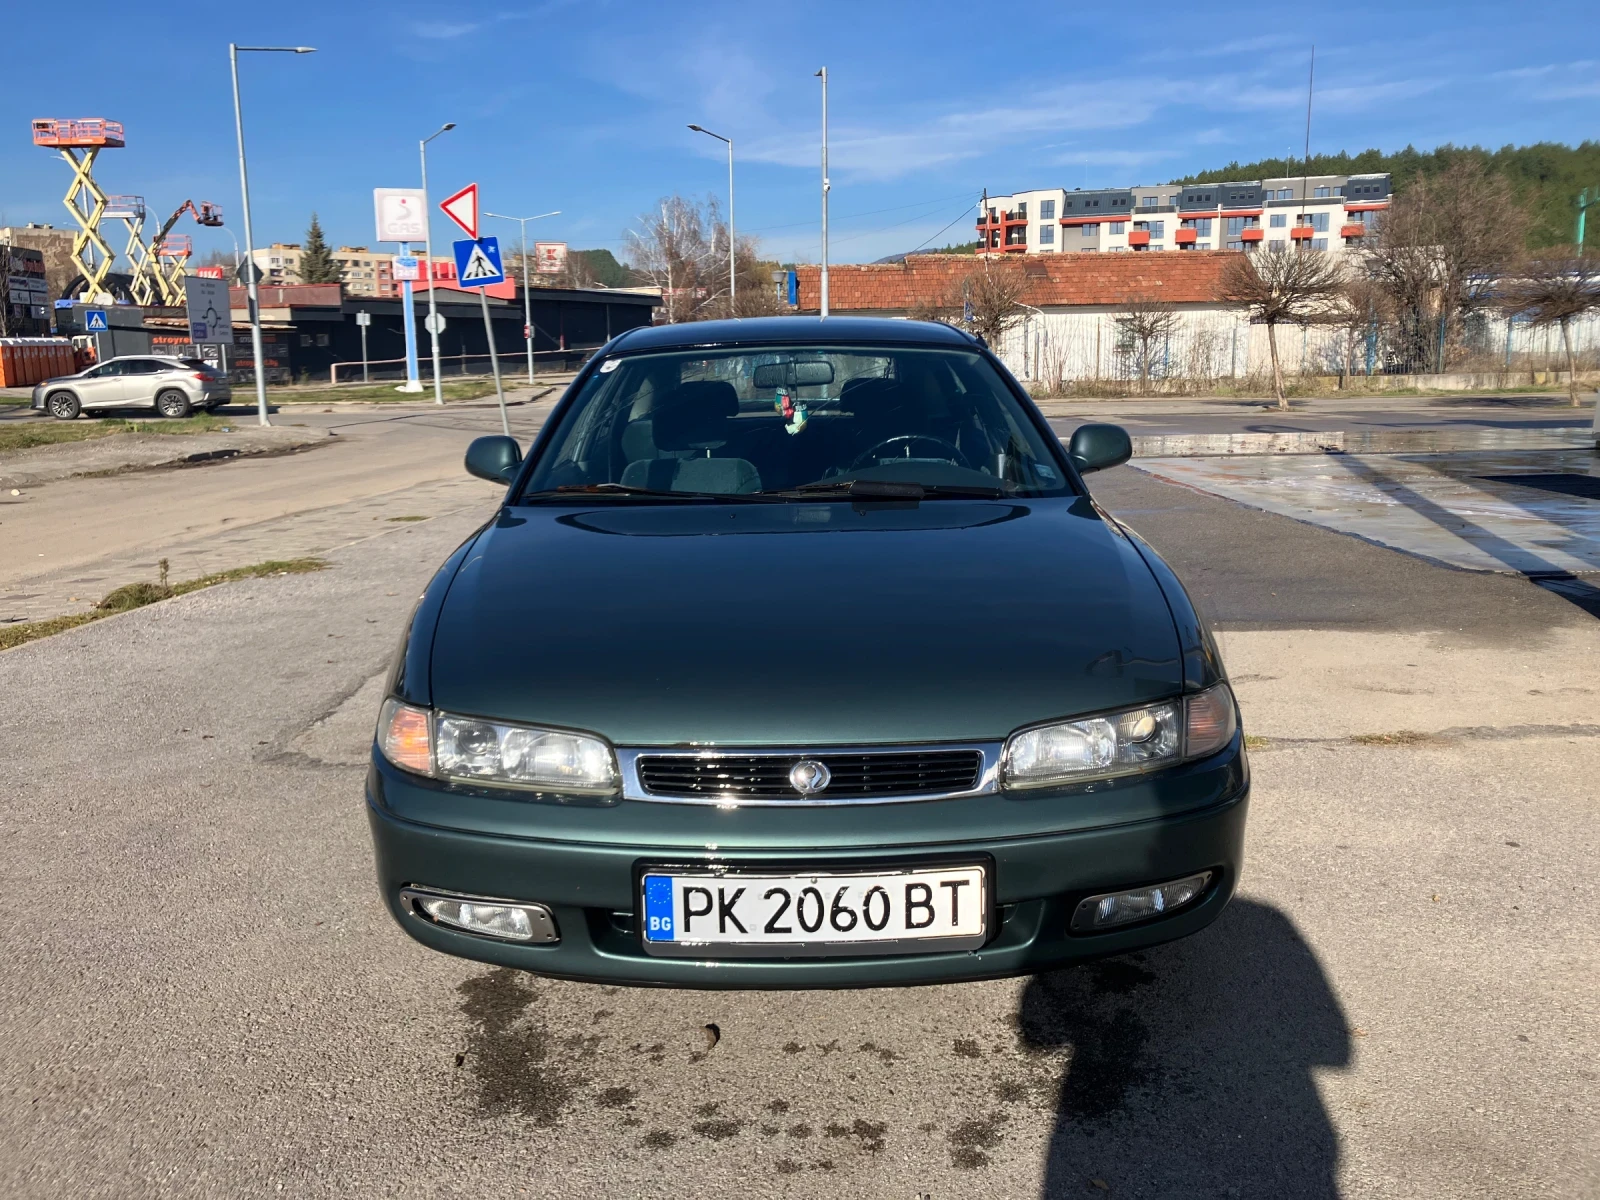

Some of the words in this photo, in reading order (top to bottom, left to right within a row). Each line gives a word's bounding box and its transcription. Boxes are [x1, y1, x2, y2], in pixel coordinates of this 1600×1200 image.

[387, 222, 421, 234] GAS
[152, 336, 192, 345] stroyre
[682, 886, 749, 934] PK
[763, 884, 891, 934] 2060
[904, 879, 970, 930] BT
[650, 916, 671, 931] BG
